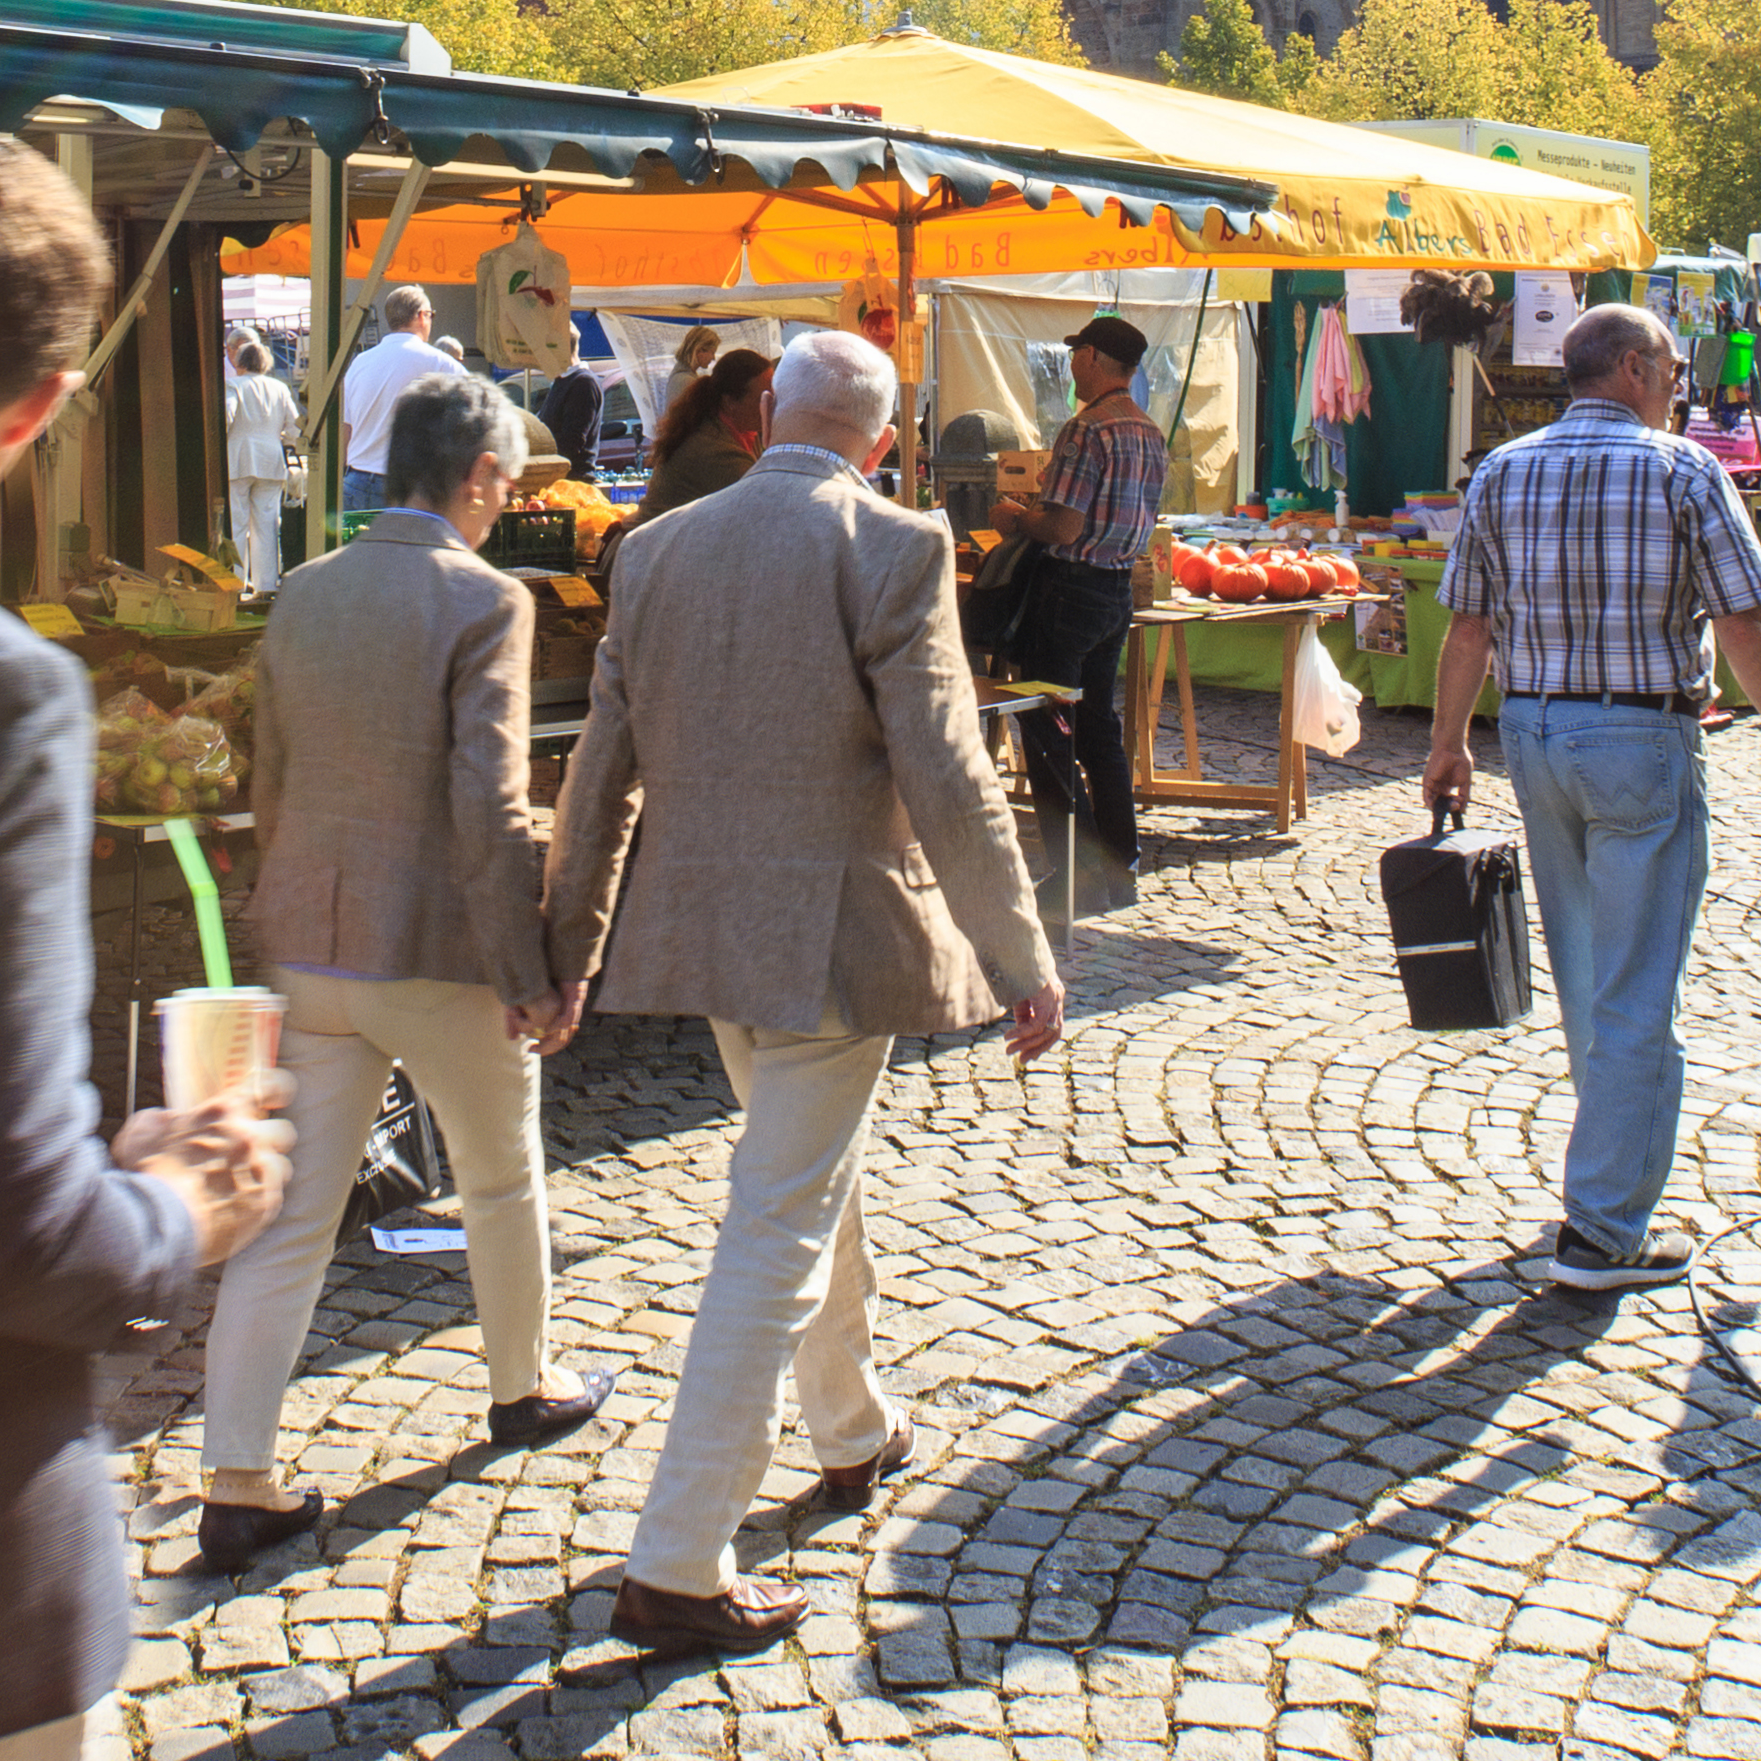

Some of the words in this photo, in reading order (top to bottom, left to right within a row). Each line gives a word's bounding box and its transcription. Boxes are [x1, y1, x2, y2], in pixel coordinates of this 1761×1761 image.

[1537, 149, 1591, 169] Messeprodukte
[1601, 159, 1636, 176] Neuheiten
[1375, 217, 1473, 255] Albers
[1474, 209, 1531, 256] Bad
[1545, 215, 1635, 257] Essen
